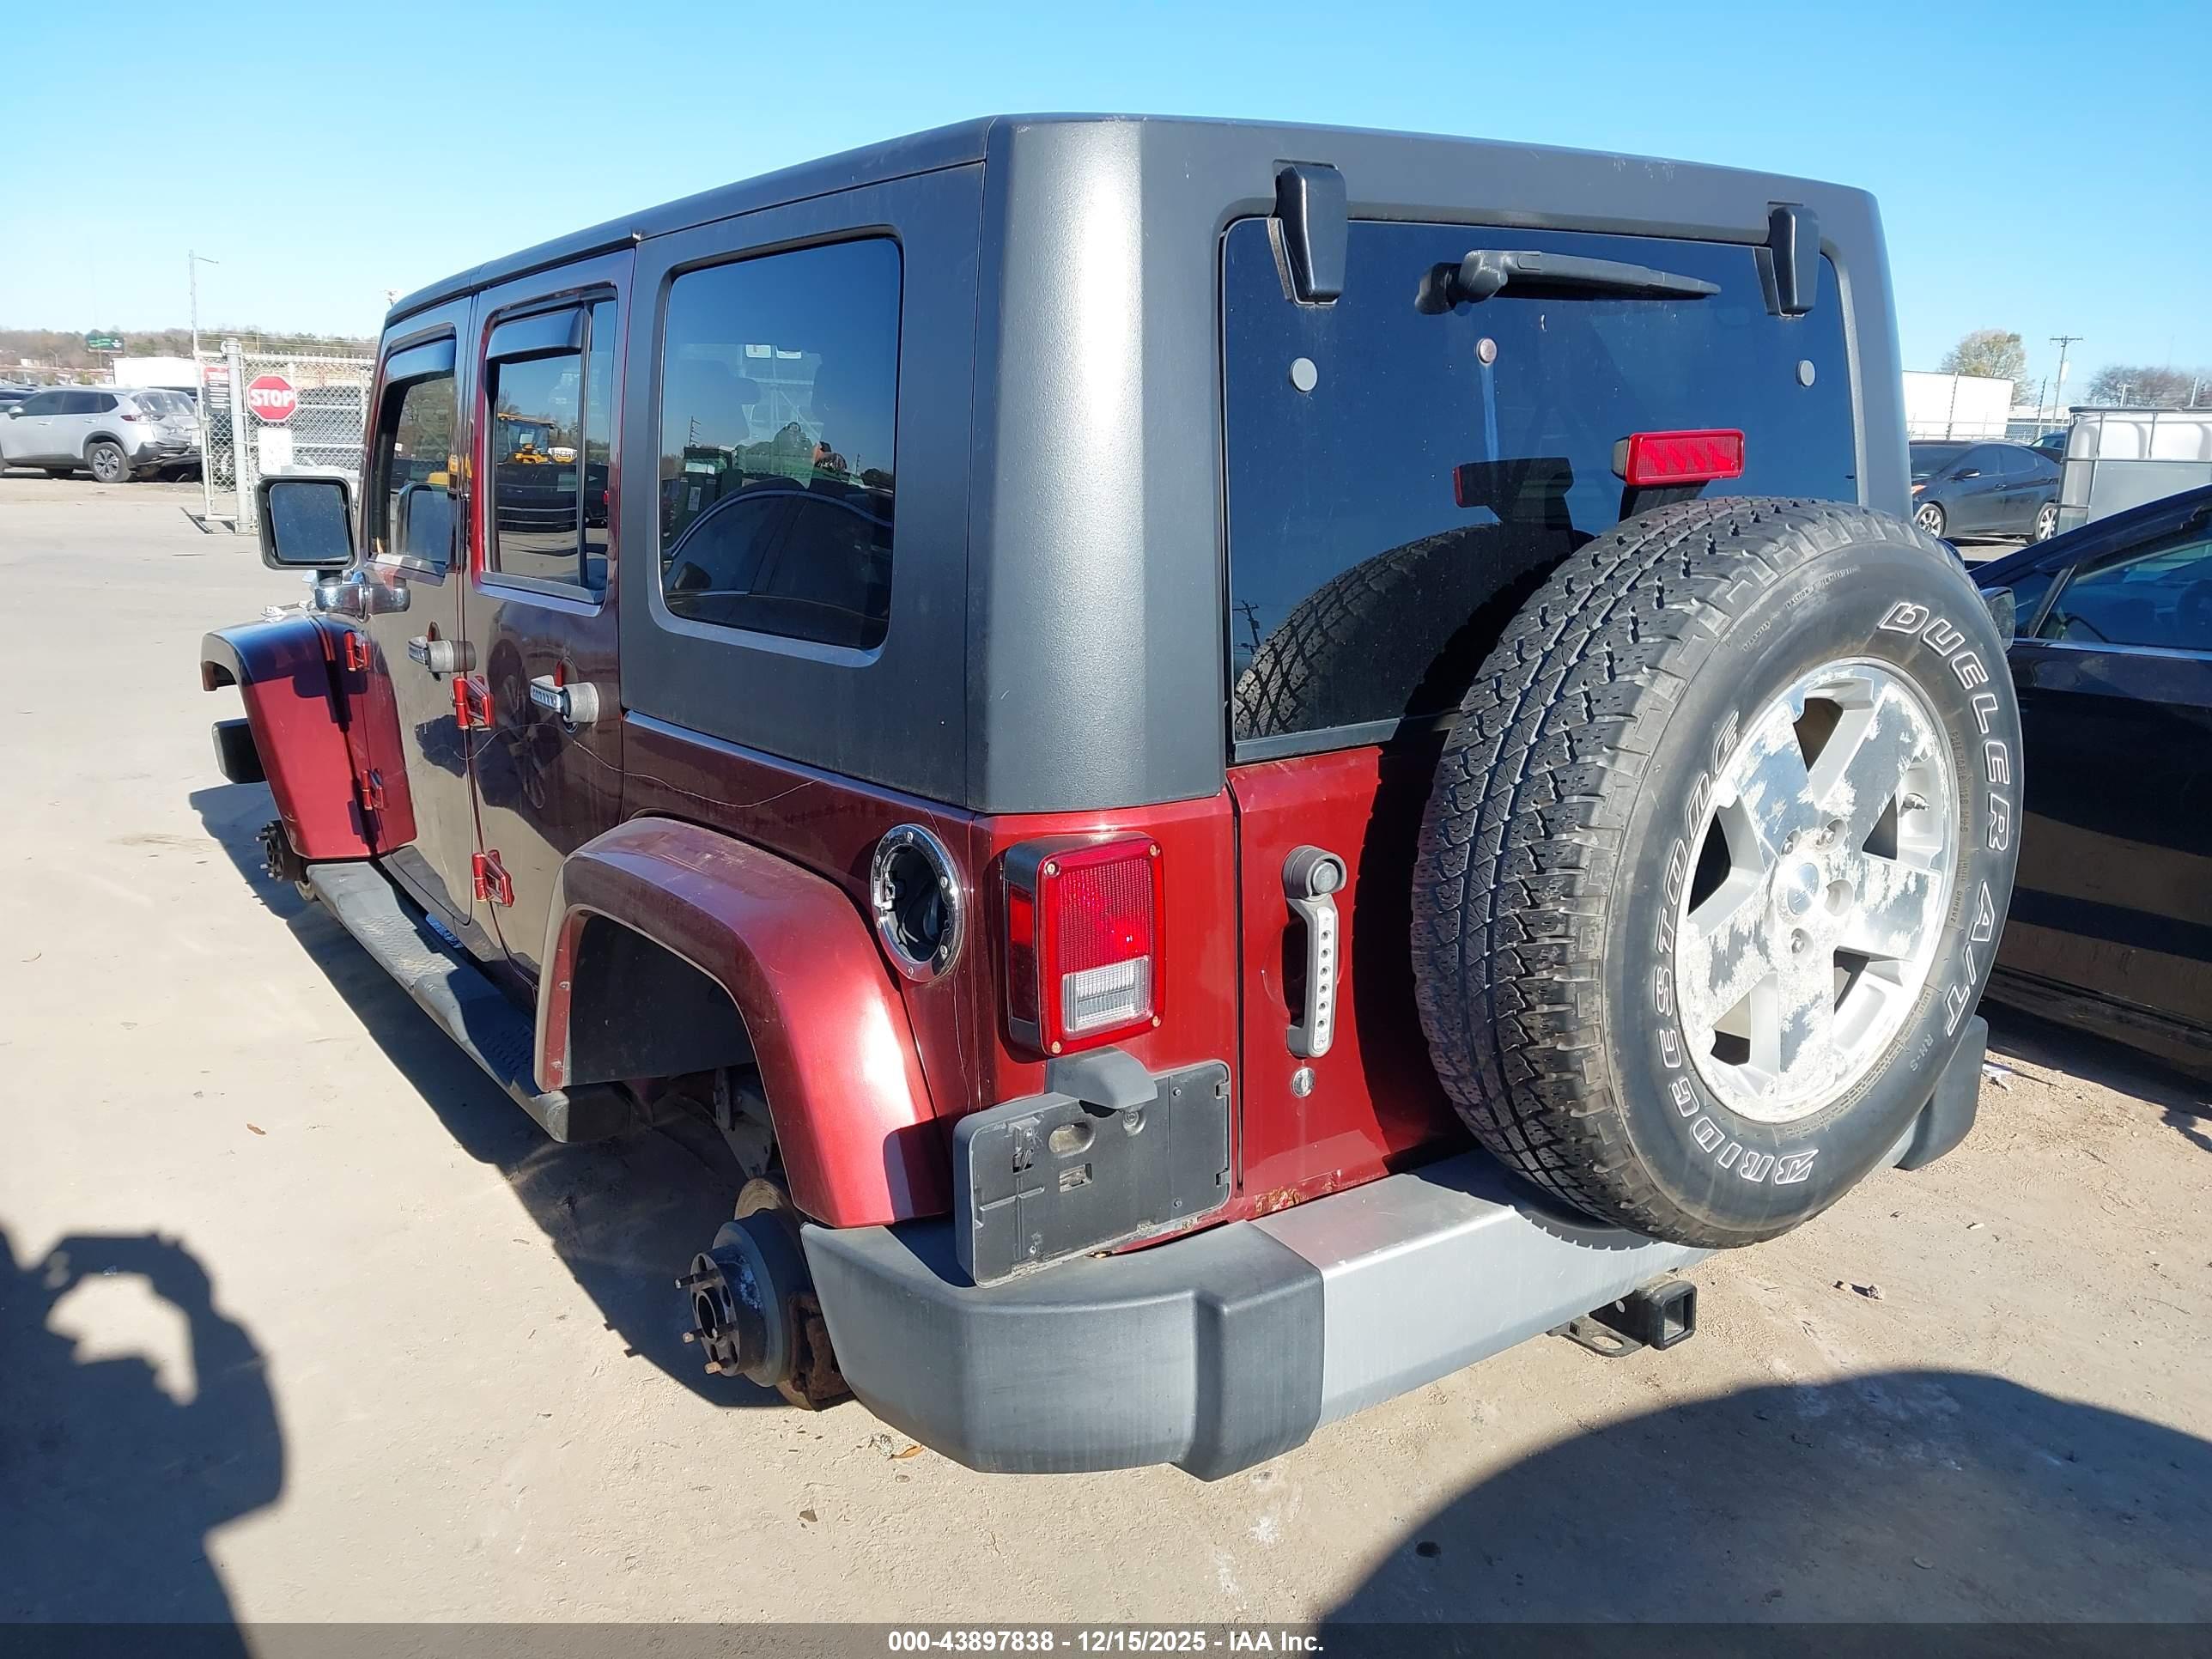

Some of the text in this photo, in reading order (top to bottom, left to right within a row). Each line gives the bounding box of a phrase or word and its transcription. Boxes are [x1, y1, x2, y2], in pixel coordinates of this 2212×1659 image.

[250, 388, 294, 408] STOP
[1876, 601, 2013, 1037] DUELER A/T
[1654, 709, 1819, 1187] BRIDGESTONE
[1909, 1033, 1934, 1072] RH-S
